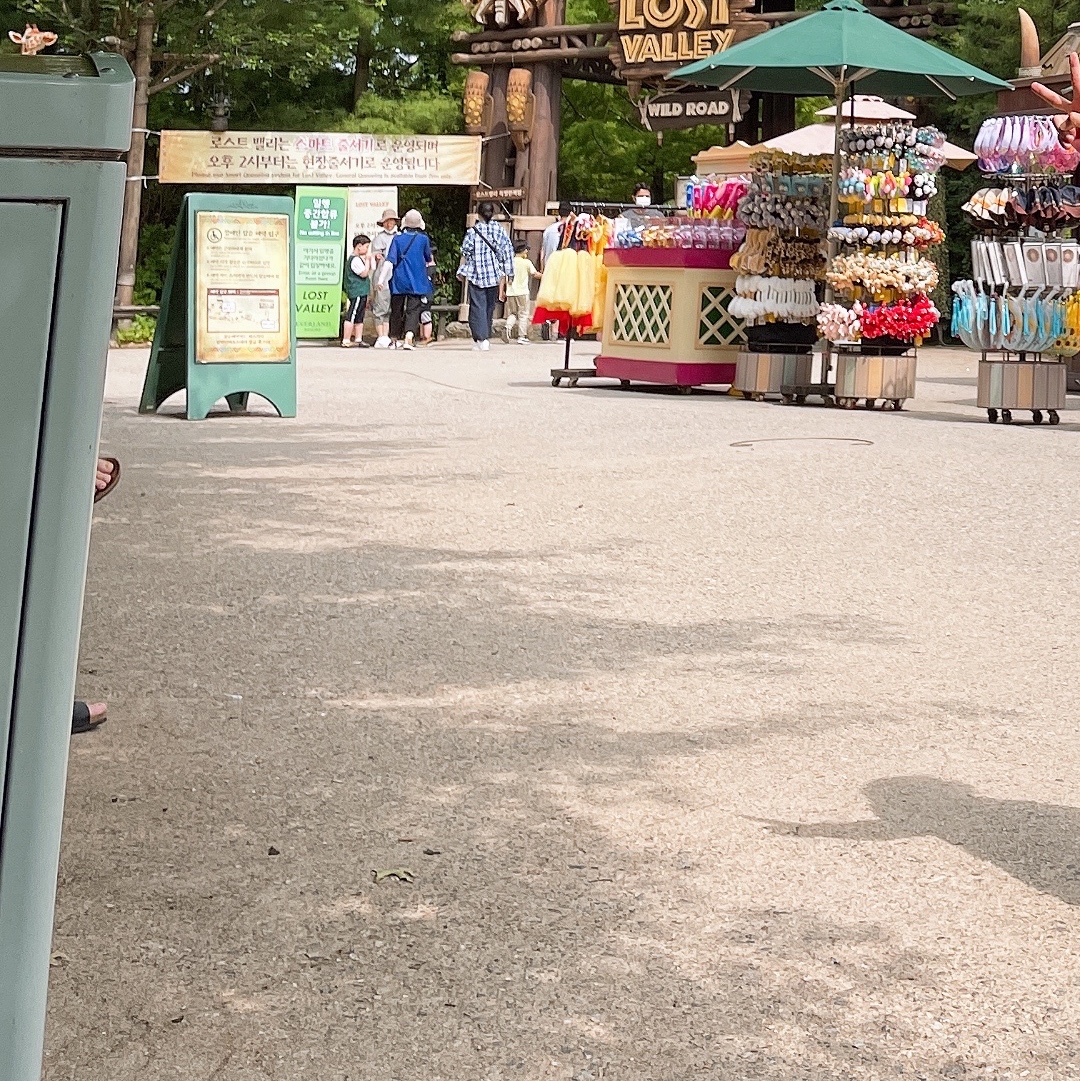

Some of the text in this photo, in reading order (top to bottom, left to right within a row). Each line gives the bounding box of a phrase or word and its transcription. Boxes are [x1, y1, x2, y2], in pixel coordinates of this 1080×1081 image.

[620, 28, 736, 64] VALLEY
[648, 101, 729, 117] WILD ROAD
[210, 136, 439, 153] 로스트 밸리는 스마트 줄서기로 운영되며
[208, 155, 234, 169] 오후
[239, 155, 298, 169] 2시부터는
[381, 156, 440, 170] 운영됩니다
[312, 198, 331, 209] 일행
[303, 208, 338, 219] 중간합류
[310, 219, 331, 230] 불가!
[303, 291, 329, 300] LOST
[296, 304, 334, 314] VALLEY
